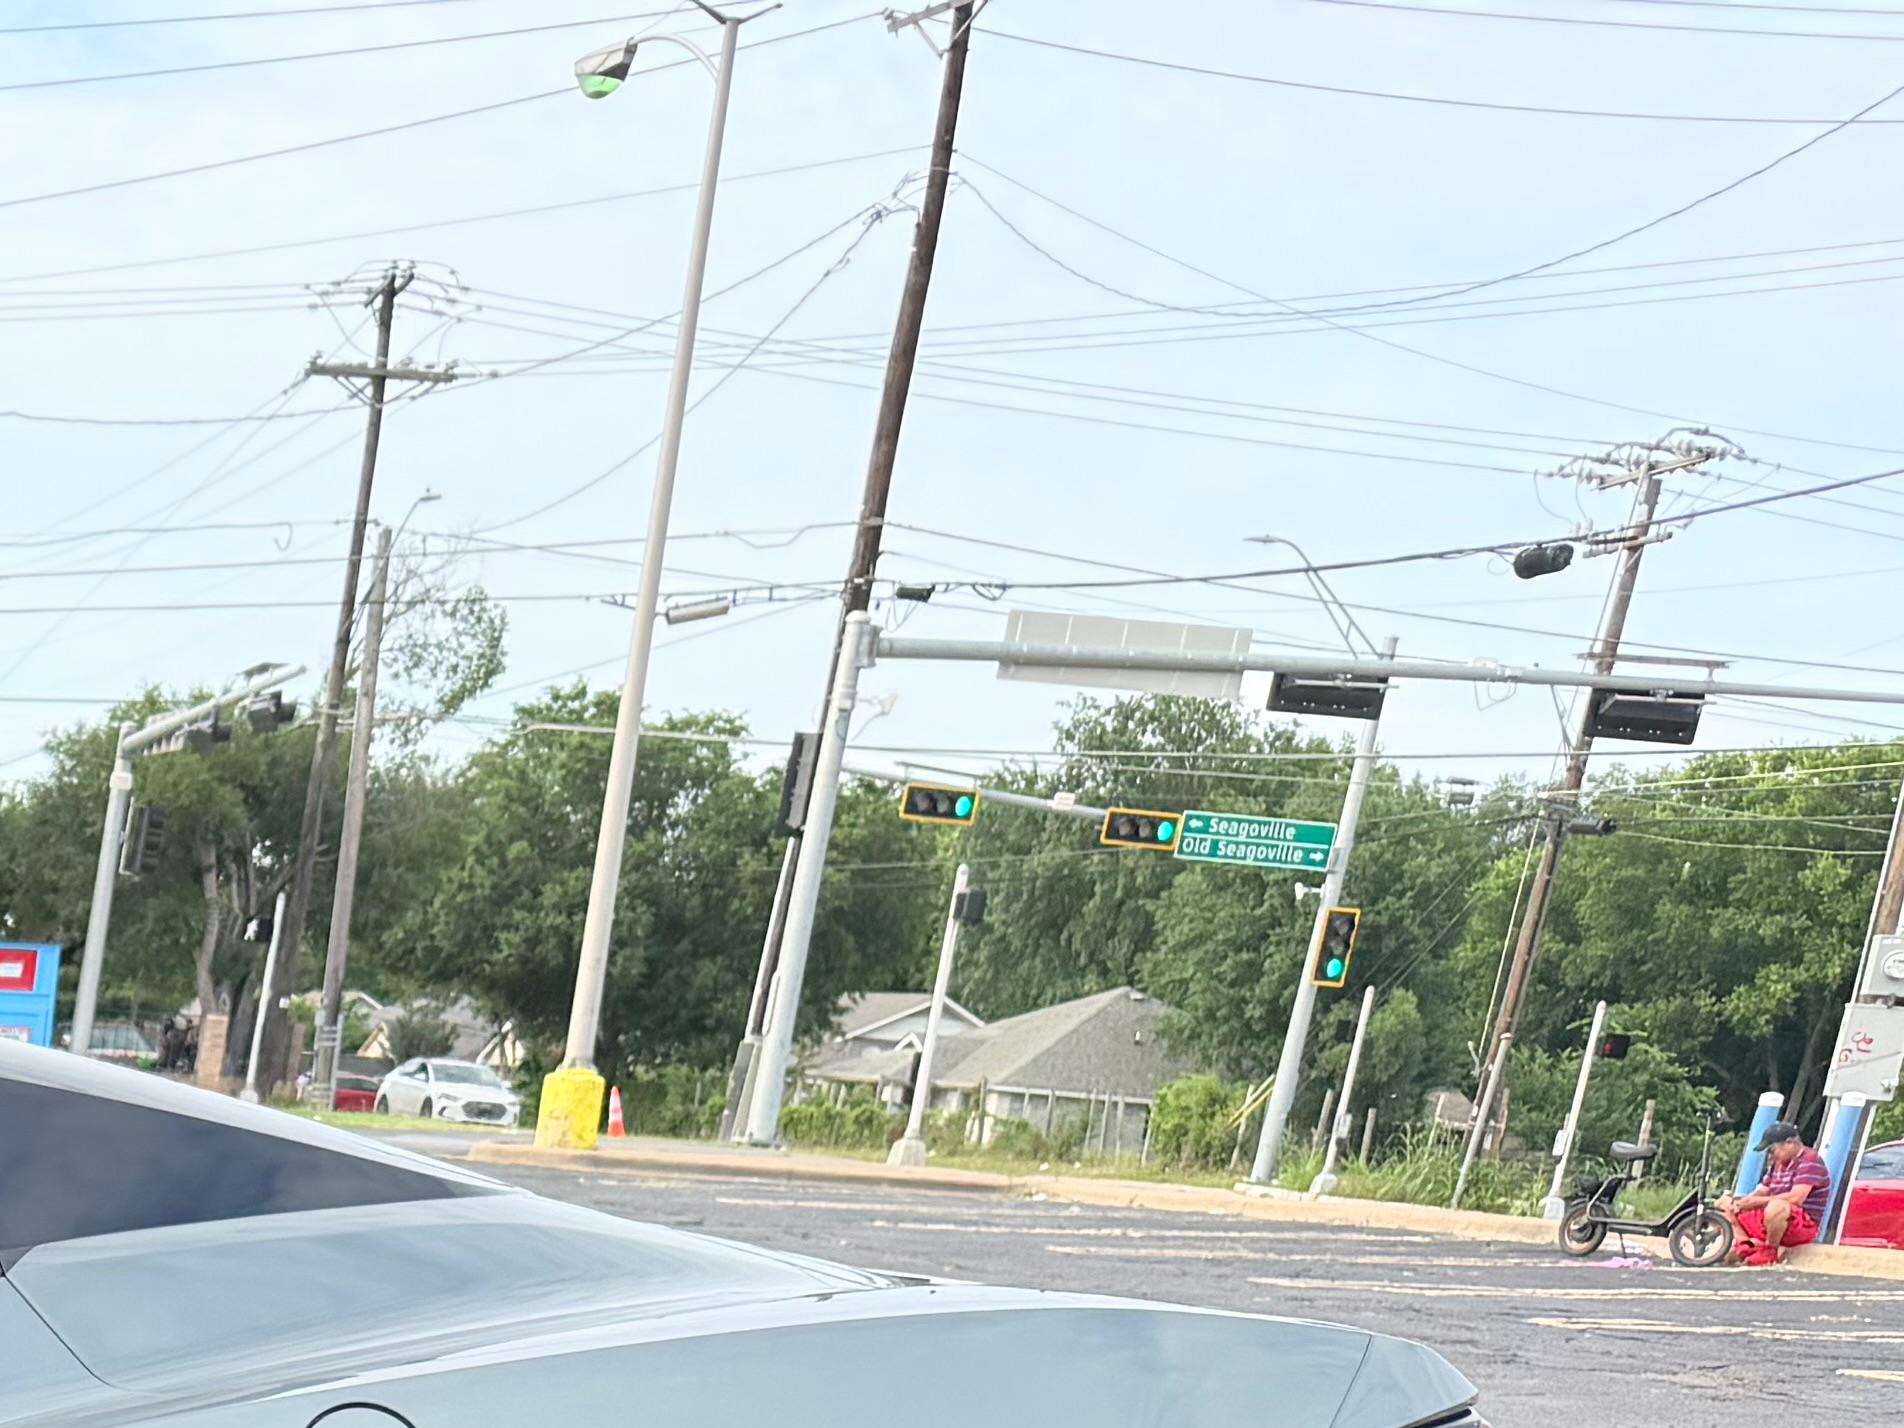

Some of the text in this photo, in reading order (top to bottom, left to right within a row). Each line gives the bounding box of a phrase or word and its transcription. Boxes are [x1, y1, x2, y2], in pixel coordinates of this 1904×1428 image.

[1209, 818, 1296, 840] Seagoville
[1182, 837, 1303, 862] Old Seagoville
